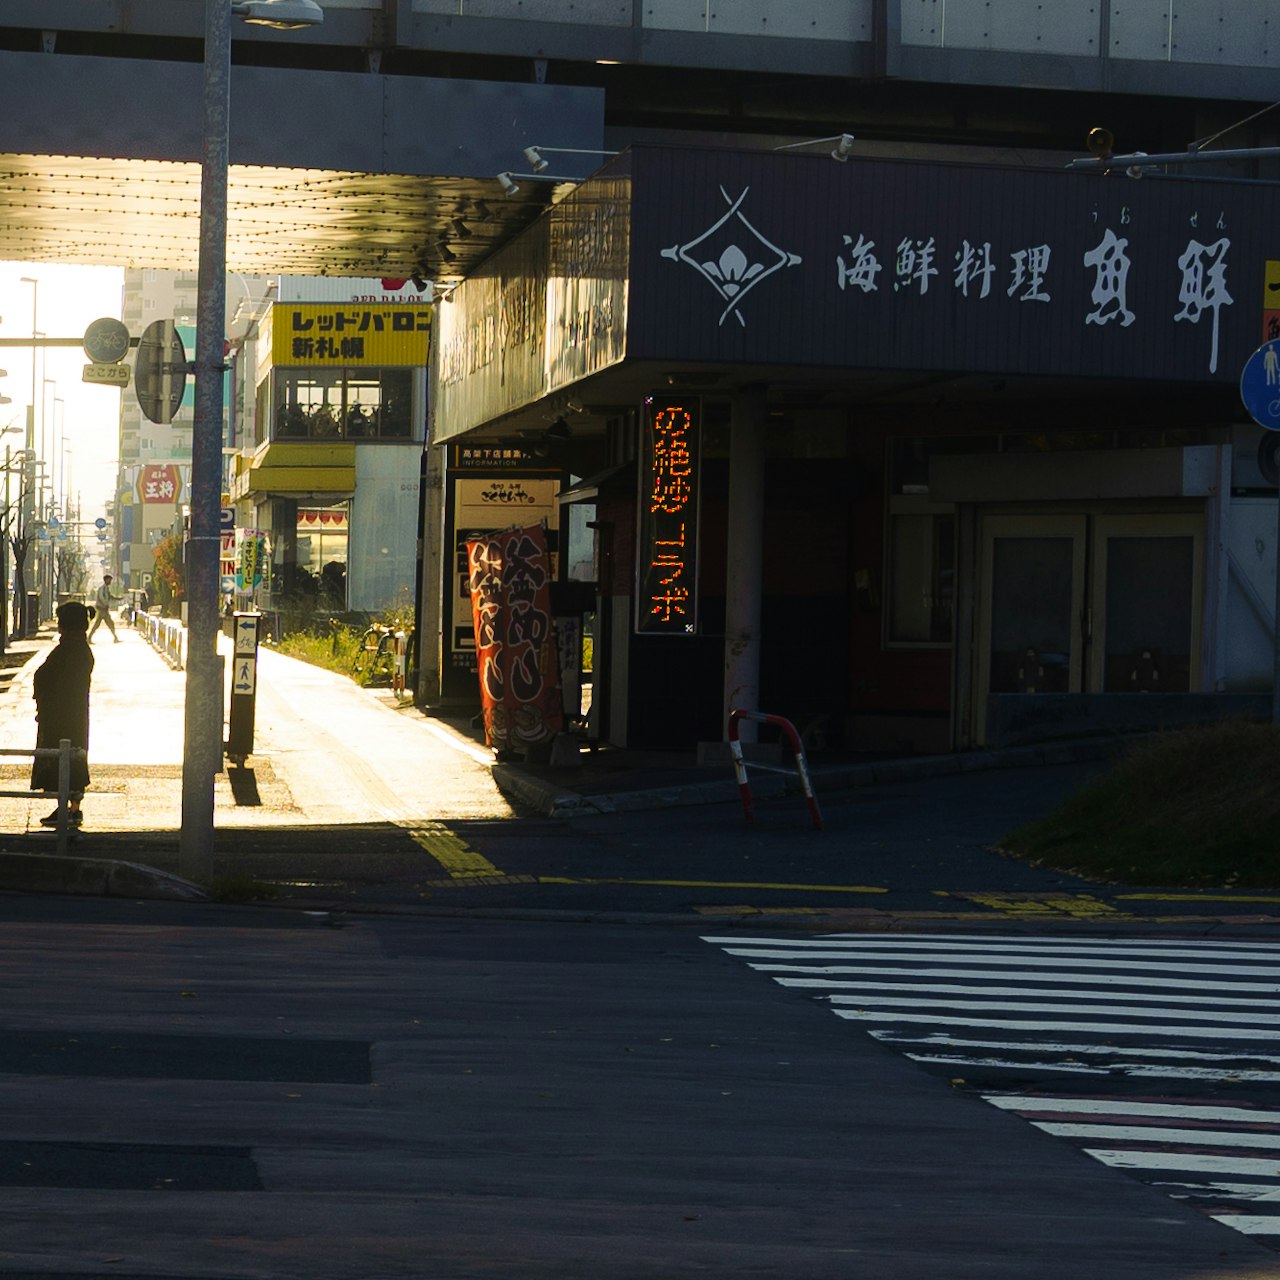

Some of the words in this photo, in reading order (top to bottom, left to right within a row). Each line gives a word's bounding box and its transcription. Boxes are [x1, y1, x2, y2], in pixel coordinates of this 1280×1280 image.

[836, 233, 1052, 303] 海鮮料理
[292, 337, 365, 359] 新札幌
[86, 367, 128, 378] ここから
[145, 480, 174, 498] 王将
